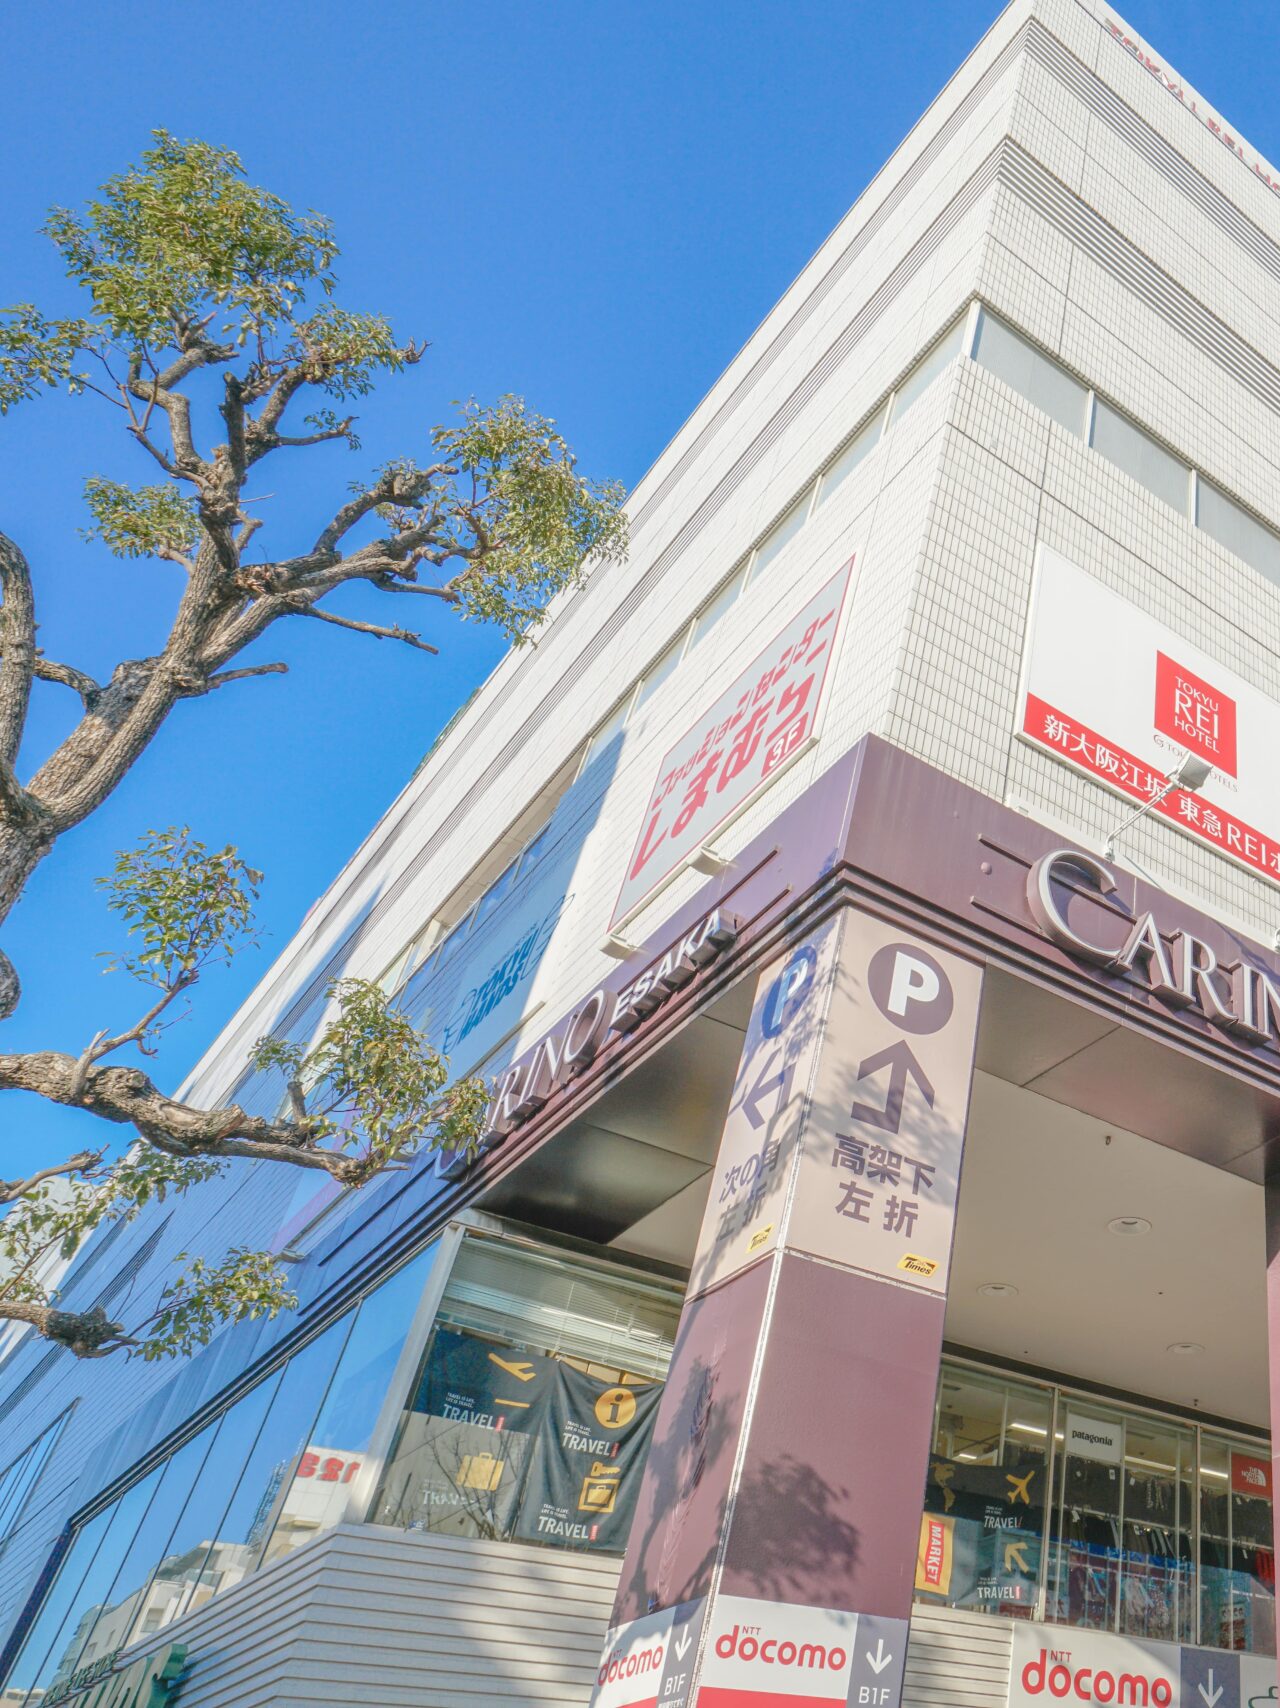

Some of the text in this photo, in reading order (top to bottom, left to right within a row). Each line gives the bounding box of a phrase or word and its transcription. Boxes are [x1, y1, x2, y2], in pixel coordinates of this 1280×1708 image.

[652, 608, 835, 811] ファッションセンター
[1175, 676, 1219, 711] TOKYU
[1175, 688, 1219, 739] REI
[769, 727, 799, 767] 3F
[1175, 716, 1220, 754] HOTEL
[630, 639, 827, 880] しまむら
[612, 908, 729, 1026] ESAKA
[887, 950, 940, 1017] P
[769, 957, 808, 1031] P
[722, 1138, 781, 1203] 次の角
[831, 1132, 936, 1196] 高架下
[716, 1182, 768, 1244] 左折
[835, 1180, 919, 1239] 左折
[904, 1256, 932, 1275] Times
[442, 1403, 494, 1430] TRAVEL
[562, 1432, 610, 1456] TRAVEL
[1072, 1430, 1113, 1447] patagonia
[537, 1516, 589, 1539] TRAVEL
[984, 1515, 1018, 1529] TRAVEL
[927, 1525, 942, 1582] MARKET
[977, 1586, 1015, 1599] TRAVEL
[715, 1625, 847, 1671] docomo
[741, 1626, 761, 1636] NTT
[597, 1646, 664, 1687] docomo
[1050, 1651, 1072, 1663] NTT
[664, 1673, 686, 1696] B1F
[858, 1686, 891, 1705] B1F
[1021, 1648, 1172, 1708] docomo
